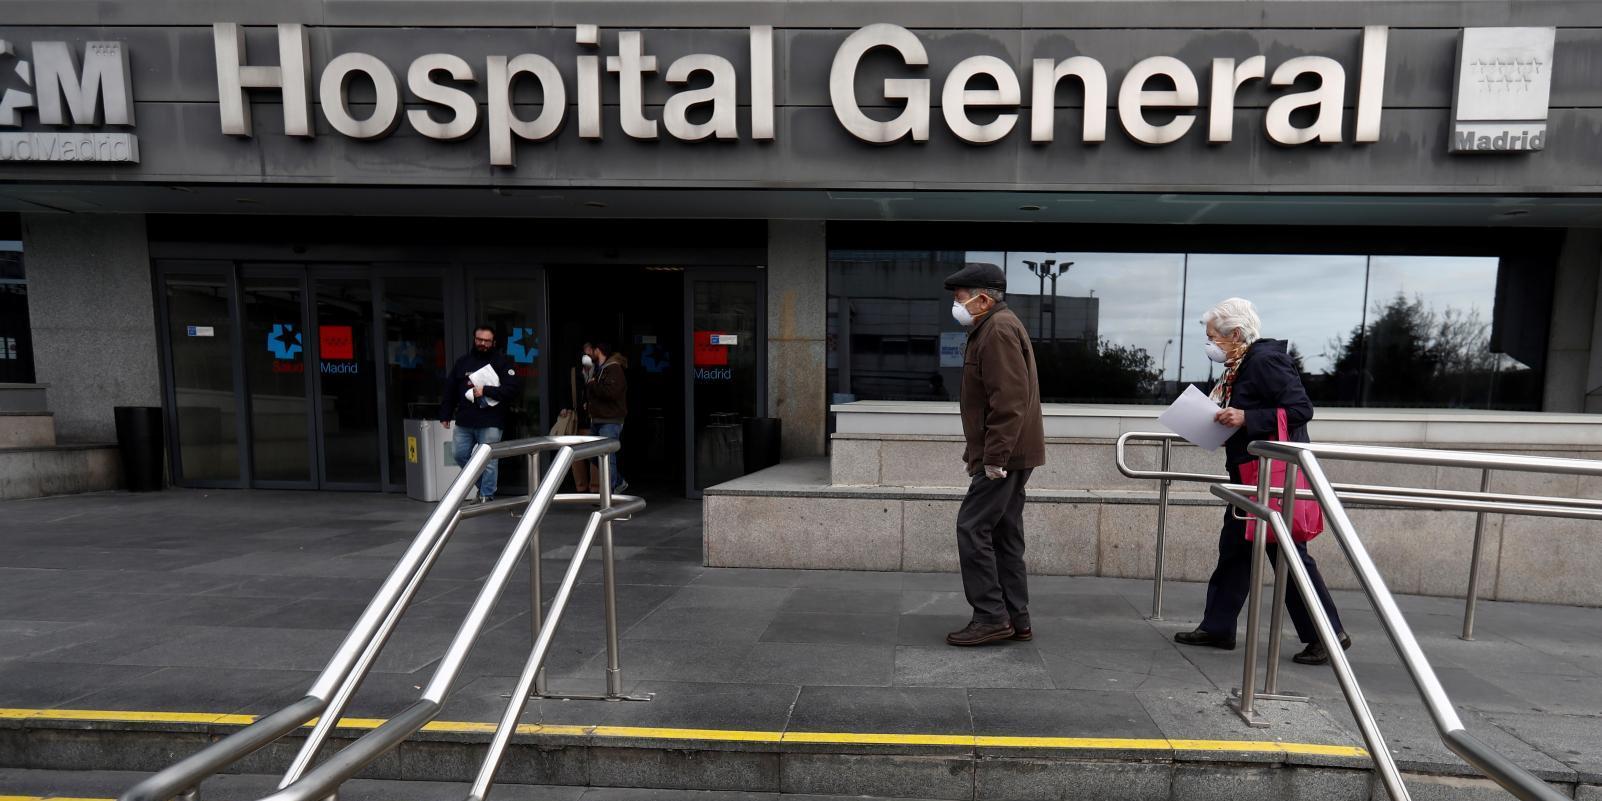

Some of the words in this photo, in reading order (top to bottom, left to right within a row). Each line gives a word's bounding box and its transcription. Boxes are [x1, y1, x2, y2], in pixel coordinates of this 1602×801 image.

[213, 22, 775, 167] Hospital
[829, 22, 1389, 145] General
[1455, 130, 1546, 151] Madrid
[320, 361, 358, 374] Madrid
[693, 367, 731, 380] Madrid
